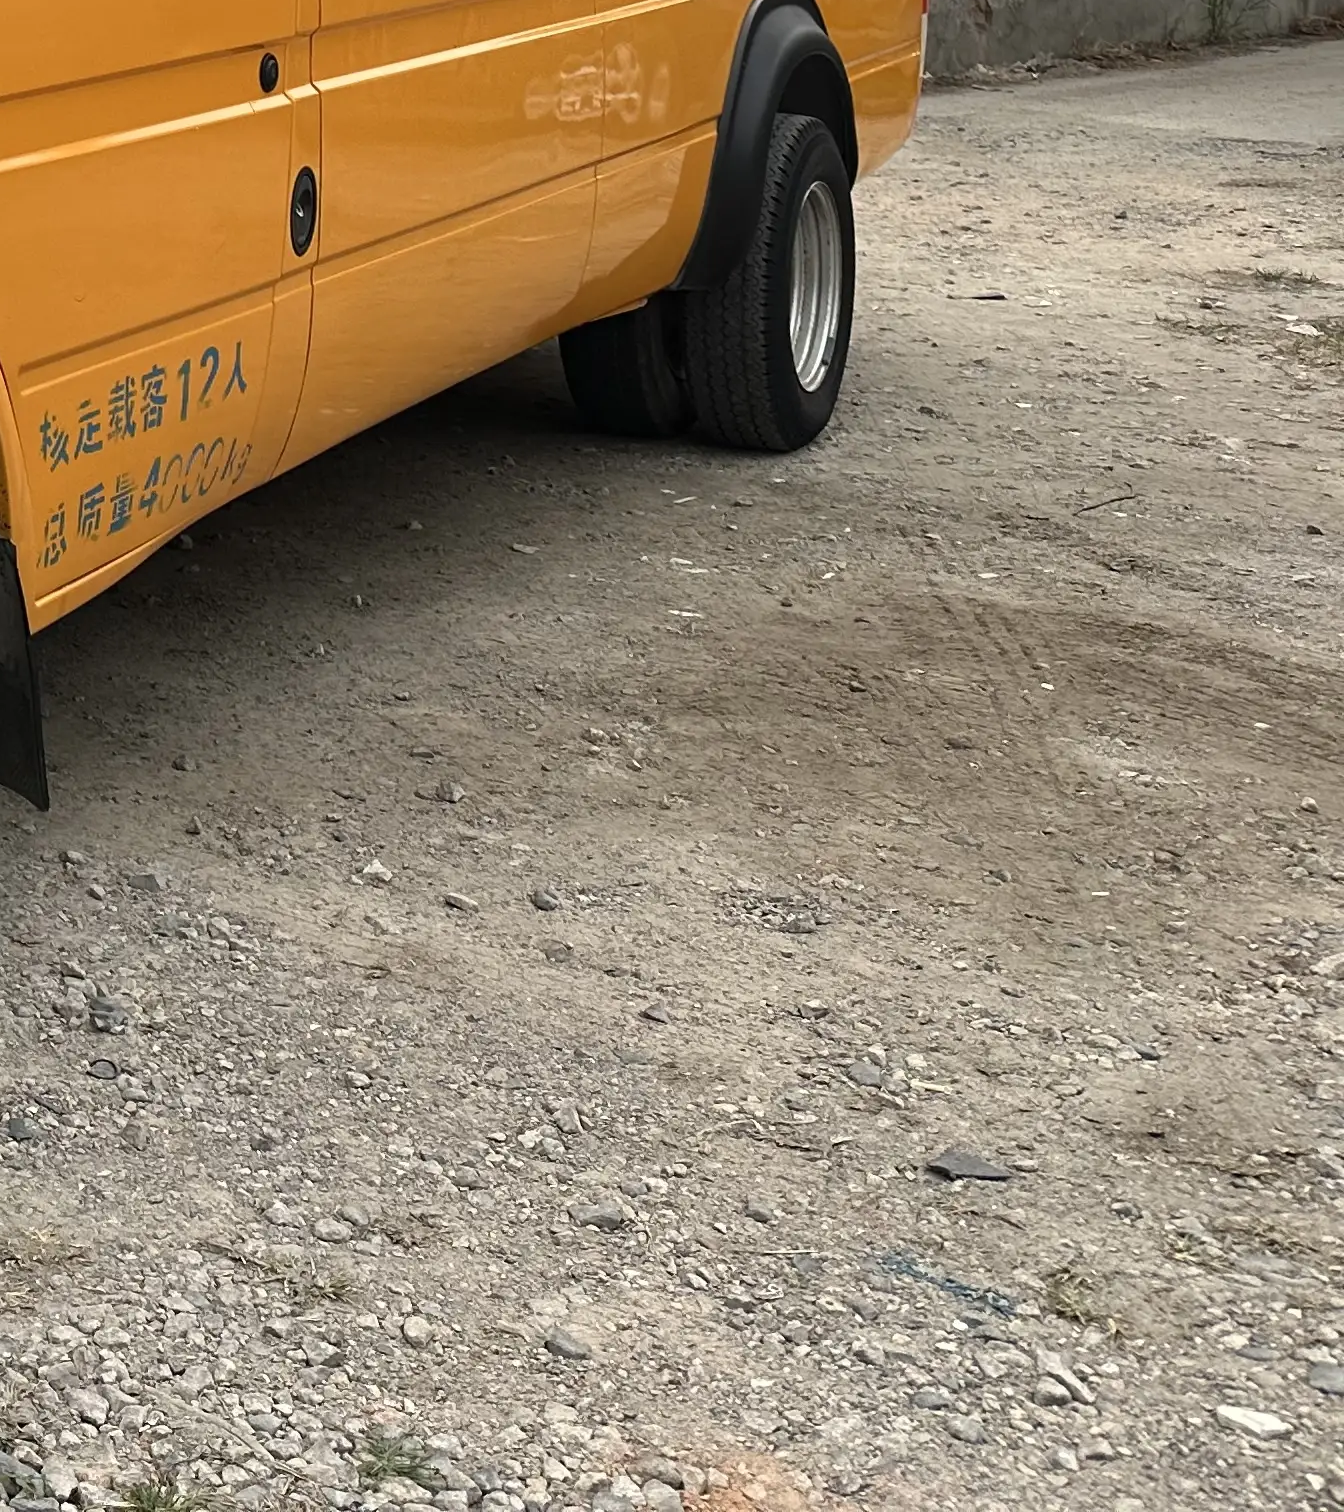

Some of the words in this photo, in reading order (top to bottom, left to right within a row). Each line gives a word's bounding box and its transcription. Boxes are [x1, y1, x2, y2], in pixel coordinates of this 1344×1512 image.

[39, 340, 248, 473] 核定载客12人
[36, 437, 253, 569] 总质量4000kg
